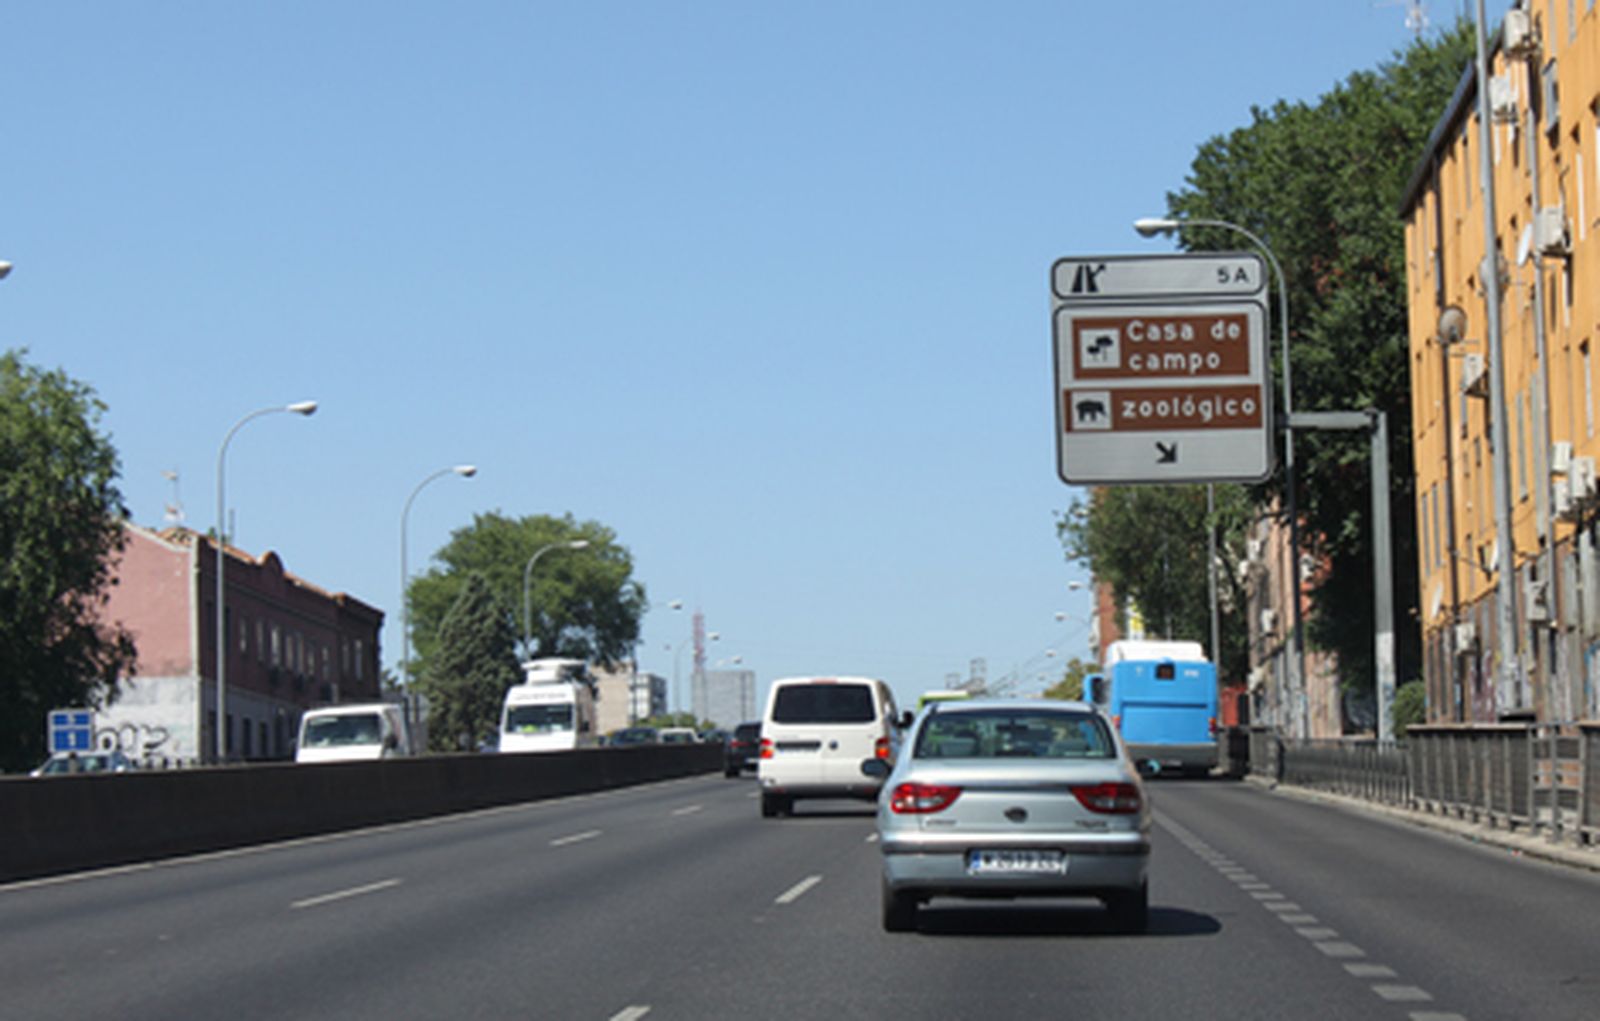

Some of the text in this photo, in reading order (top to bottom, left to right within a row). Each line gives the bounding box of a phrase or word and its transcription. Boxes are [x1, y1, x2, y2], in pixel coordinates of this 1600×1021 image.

[1126, 319, 1241, 342] Casa de
[1128, 351, 1220, 374] campo
[1121, 394, 1256, 422] zoológico
